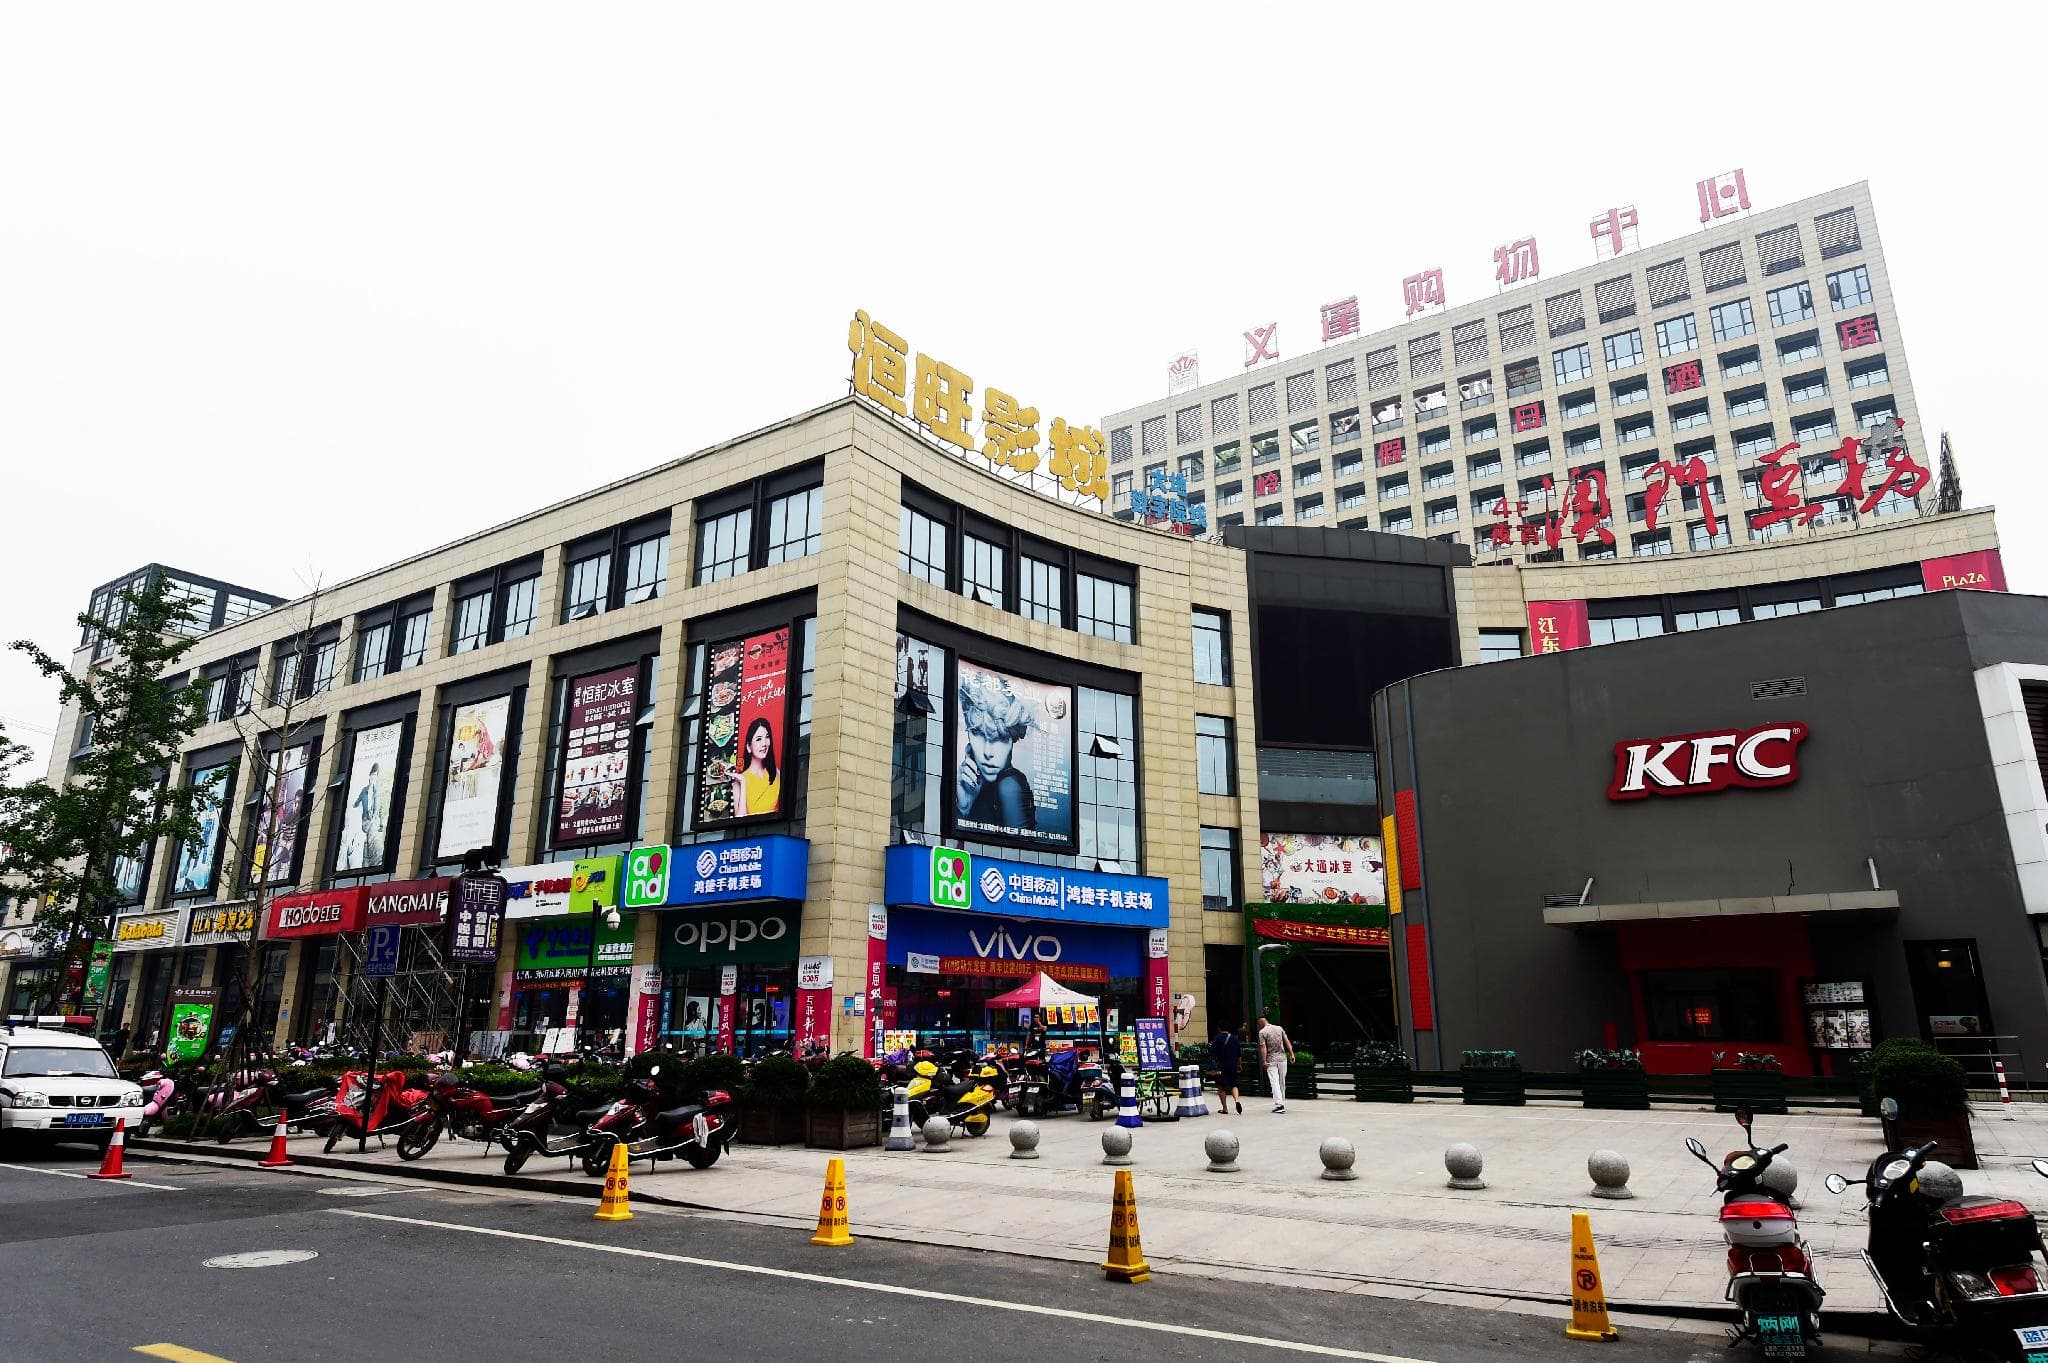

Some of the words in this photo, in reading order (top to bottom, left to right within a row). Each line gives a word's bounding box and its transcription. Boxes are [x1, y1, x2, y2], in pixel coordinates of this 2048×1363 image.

[848, 309, 1109, 500] 恒旺影城
[1942, 572, 1986, 587] PLAZA
[1537, 616, 1560, 652] 江东
[1621, 728, 1791, 791] KFC
[719, 846, 762, 863] 中国移动
[1304, 859, 1352, 874] 大通冰室
[694, 875, 762, 894] 鸿捷手机卖场
[1008, 873, 1058, 894] 中国移动
[368, 893, 434, 914] KANGNAI
[1066, 885, 1153, 910] 鸿捷手机卖场
[370, 927, 390, 961] P
